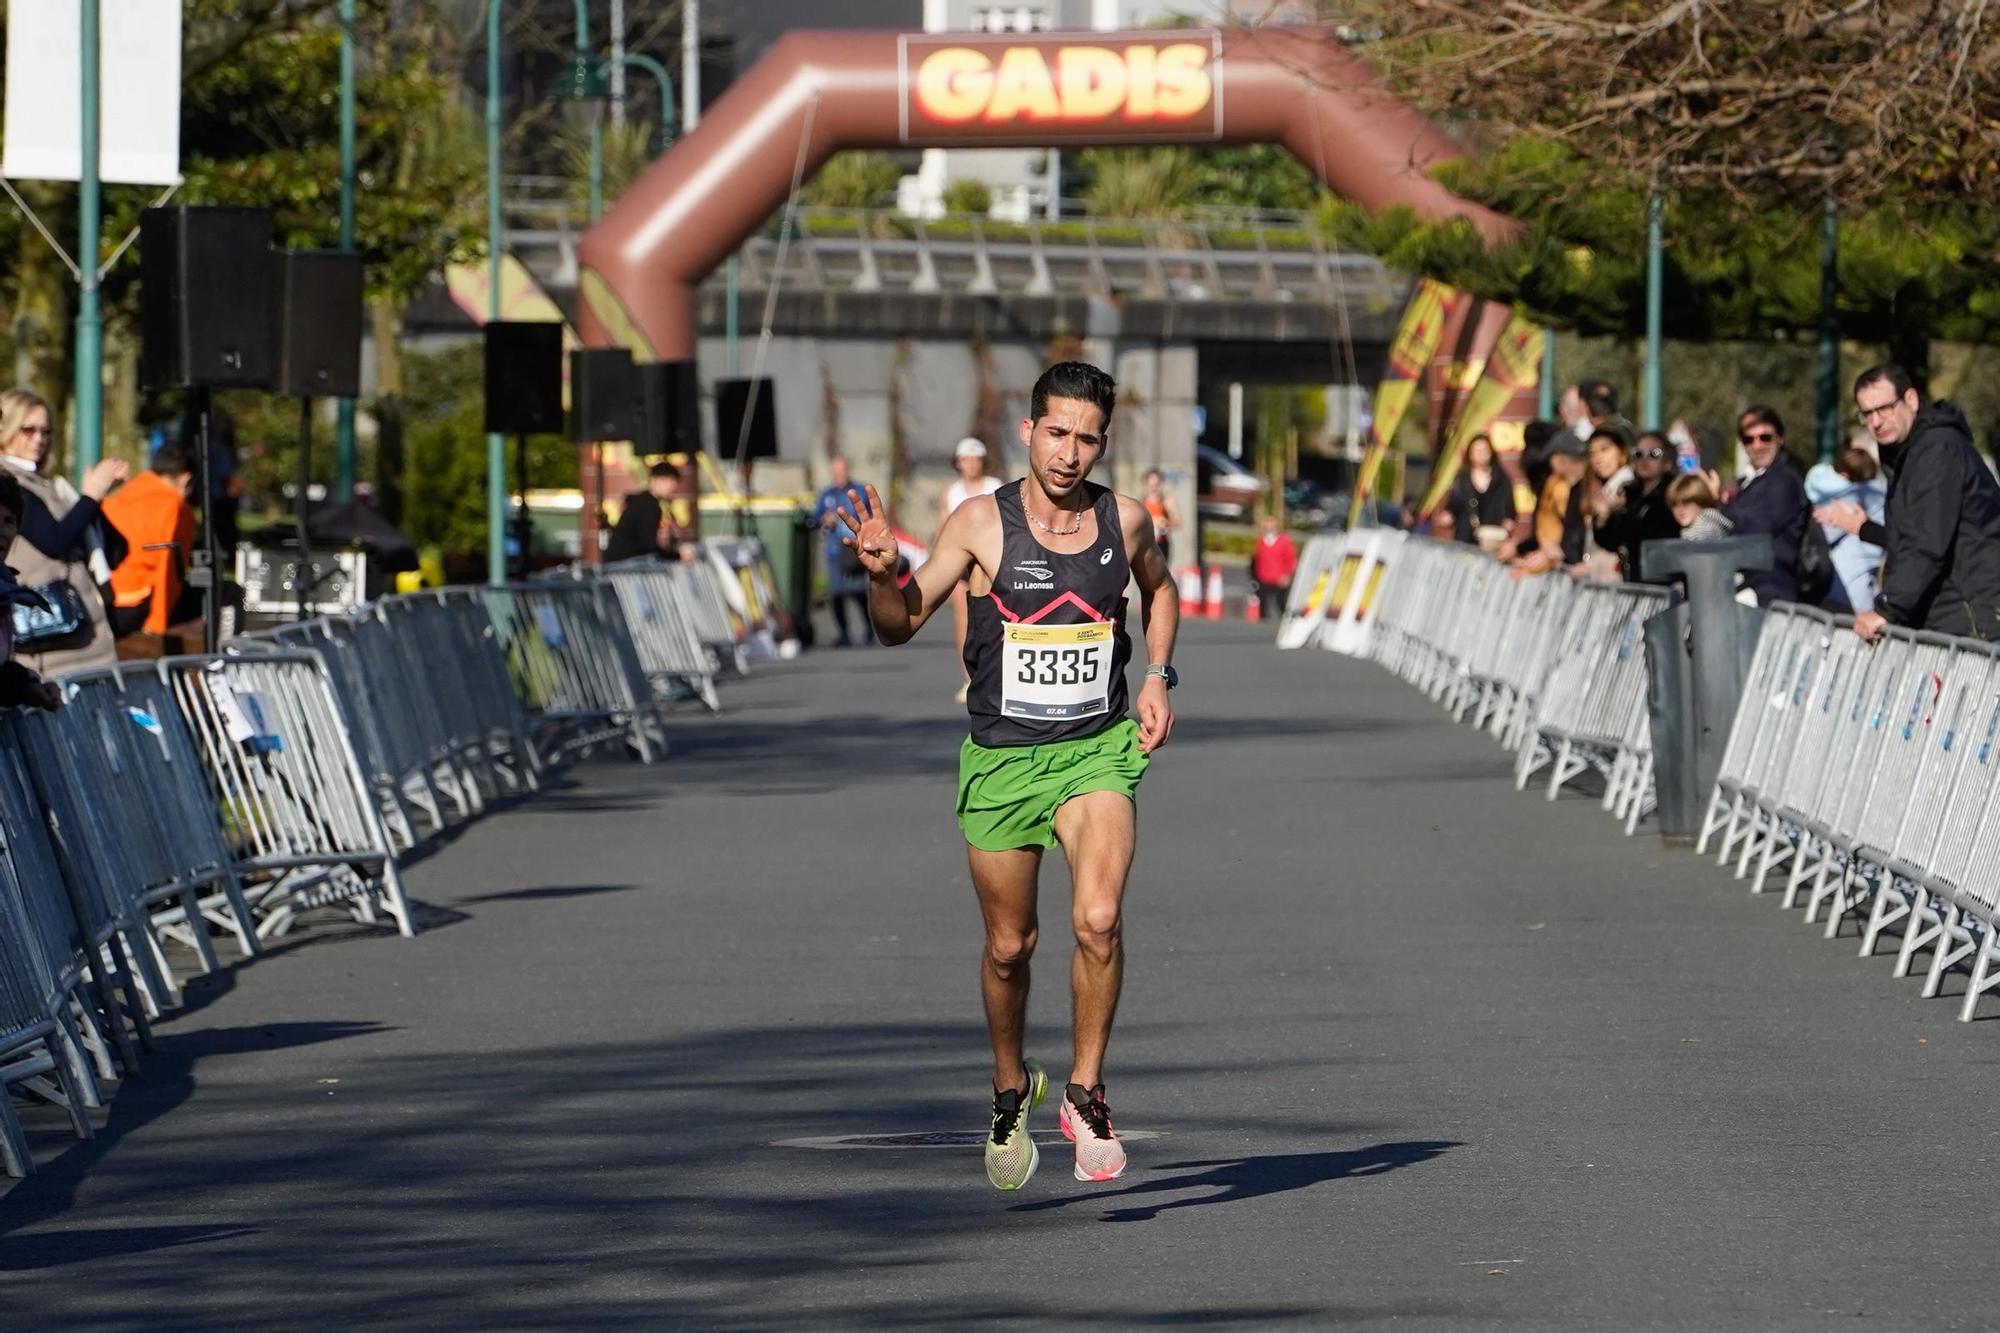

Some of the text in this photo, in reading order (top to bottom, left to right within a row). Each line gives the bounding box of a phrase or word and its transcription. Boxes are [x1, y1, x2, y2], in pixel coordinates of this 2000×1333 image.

[916, 43, 1212, 123] GADIS
[1014, 581, 1054, 590] La Leonesa
[1018, 647, 1099, 685] 3335
